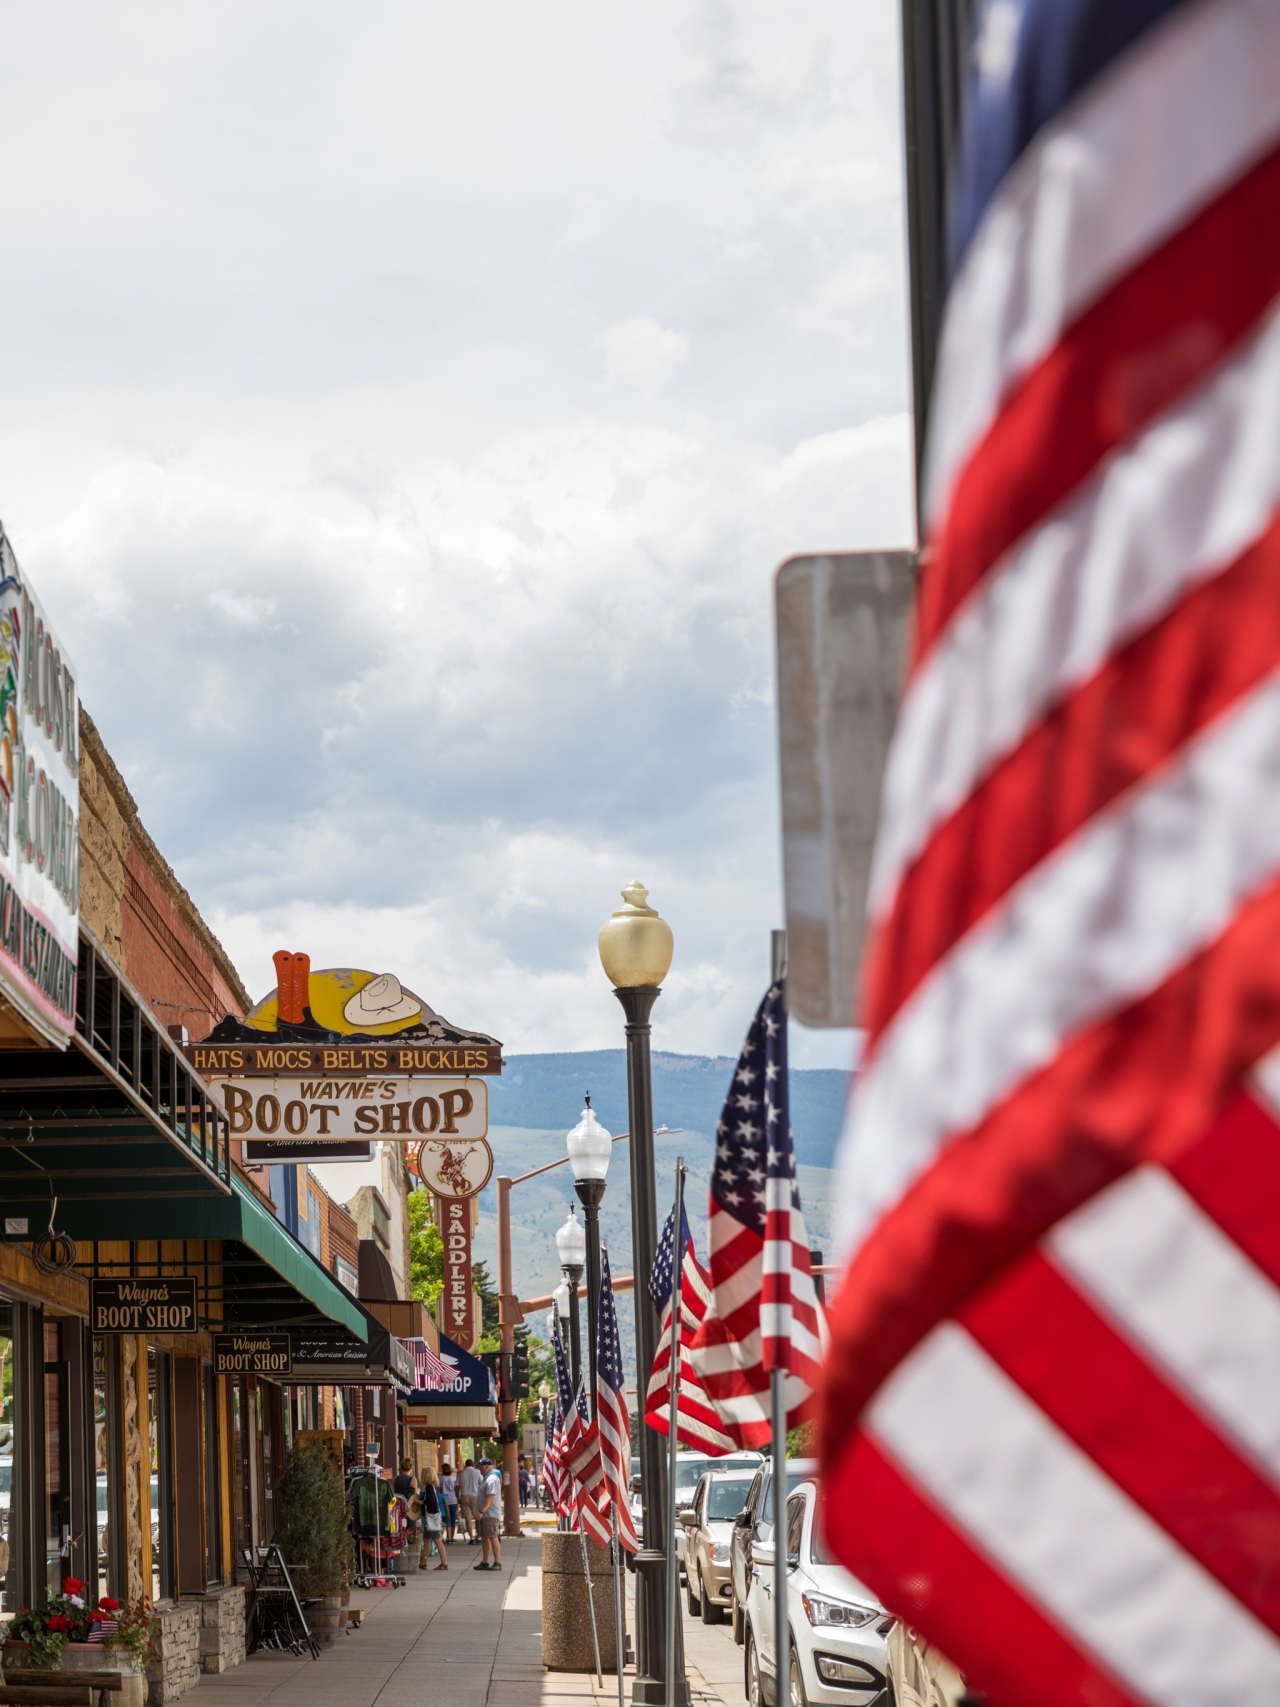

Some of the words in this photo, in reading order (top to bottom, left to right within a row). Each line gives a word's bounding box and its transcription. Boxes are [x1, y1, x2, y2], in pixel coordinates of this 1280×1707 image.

[194, 1050, 244, 1069] HATS
[256, 1050, 312, 1069] MOCS
[323, 1050, 388, 1069] BELTS
[399, 1050, 488, 1069] BUCKLES
[300, 1081, 397, 1100] WAYNE'S
[221, 1084, 340, 1135] BOOT
[354, 1088, 474, 1135] SHOP
[447, 1204, 469, 1326] SADDLERY
[117, 1281, 170, 1306] Wayne's
[97, 1306, 142, 1328] BOOT
[146, 1306, 191, 1327] SHOP
[233, 1336, 271, 1354] Wayne's
[307, 1349, 343, 1358] American
[343, 1349, 367, 1359] Cuisine
[218, 1354, 251, 1370] BOOT
[254, 1353, 287, 1370] SHOP
